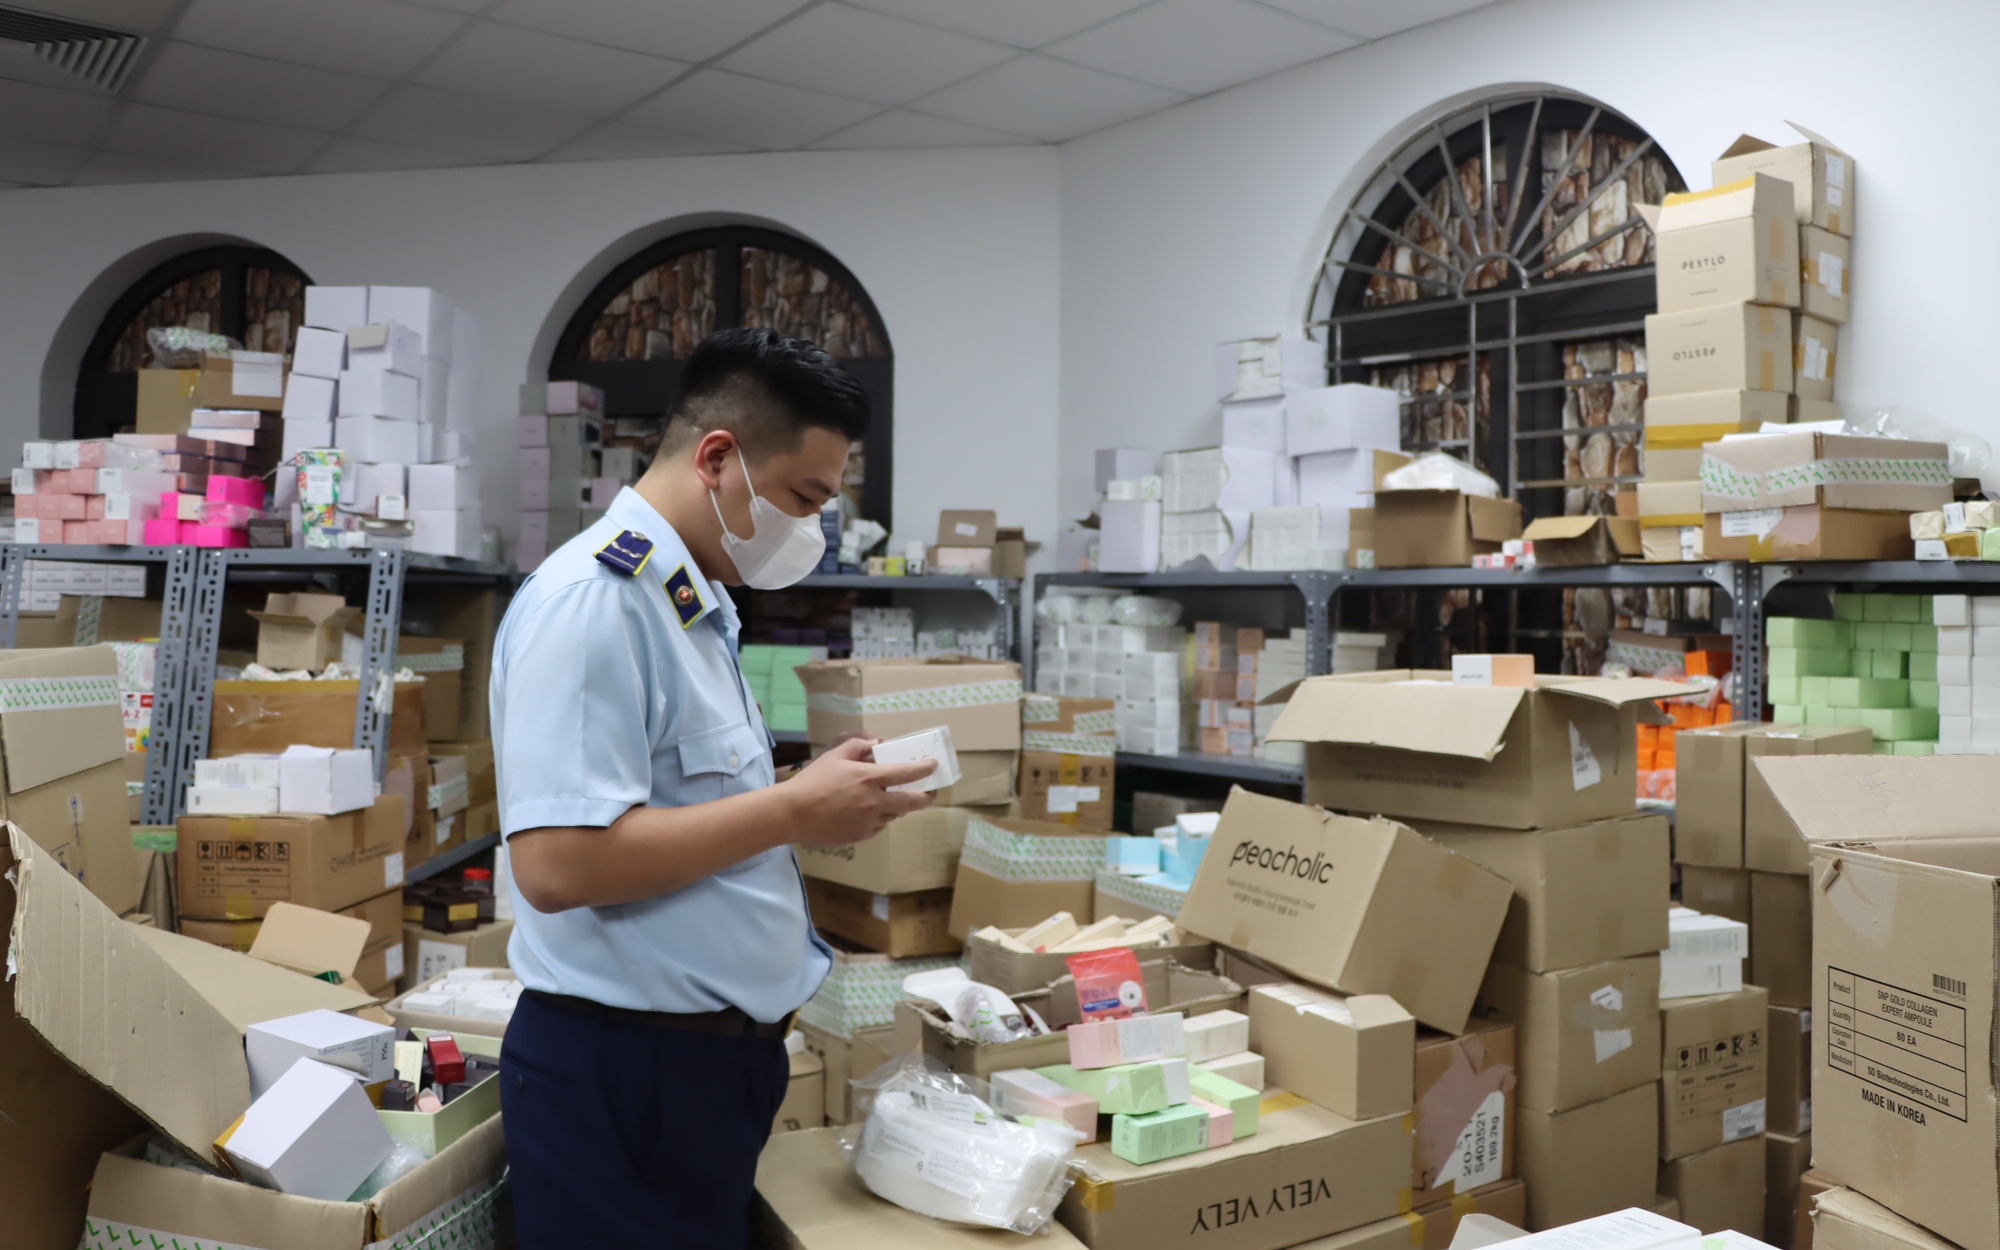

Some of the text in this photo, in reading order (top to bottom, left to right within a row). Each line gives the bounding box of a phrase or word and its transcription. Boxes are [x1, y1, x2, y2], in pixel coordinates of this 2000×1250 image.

[1682, 256, 1725, 270] PESTLO
[1673, 347, 1716, 361] PESTLO
[1229, 840, 1334, 884] peacholic
[1833, 981, 1851, 994] Product
[1832, 1009, 1852, 1023] Quantity
[1877, 990, 1938, 1018] SNP GOLD COLLAGEN
[1882, 1004, 1933, 1029] EXPERT AMPOULE
[1832, 1027, 1852, 1040] Expiration
[1896, 1031, 1917, 1046] 80 EA
[1867, 1066, 1951, 1107] SD Biotechnologies Co., Ltd.
[1861, 1087, 1926, 1127] MADE IN KOREA
[1474, 1111, 1486, 1173] S403521
[1190, 1177, 1332, 1235] VELY VELY
